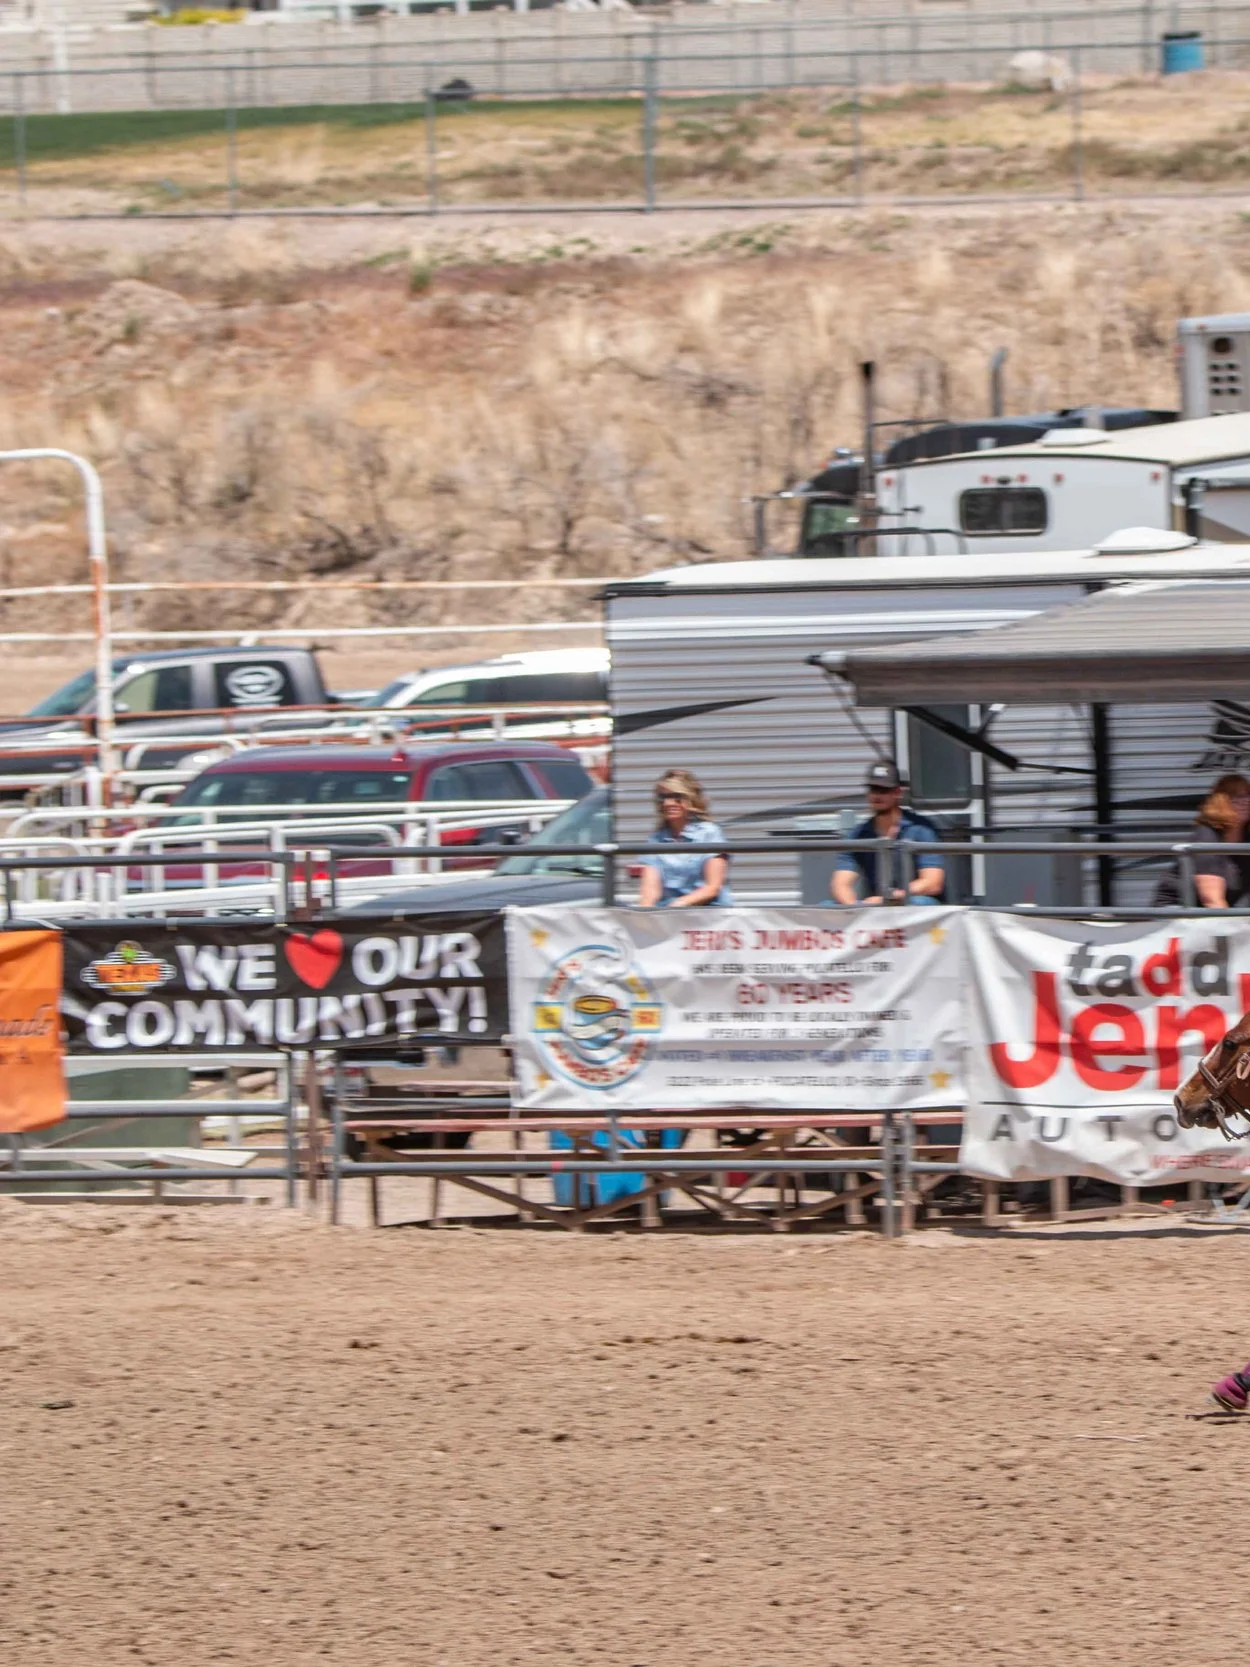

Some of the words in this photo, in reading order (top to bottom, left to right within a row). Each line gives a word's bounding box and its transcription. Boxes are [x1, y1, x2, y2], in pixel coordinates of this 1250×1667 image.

[174, 943, 277, 991] WE
[351, 931, 484, 986] OUR
[752, 929, 845, 951] JUMBOS
[1067, 935, 1230, 997] tadd
[776, 982, 853, 1004] YEARS
[85, 985, 489, 1049] COMMUNITY!
[991, 1114, 1180, 1143] AUTO
